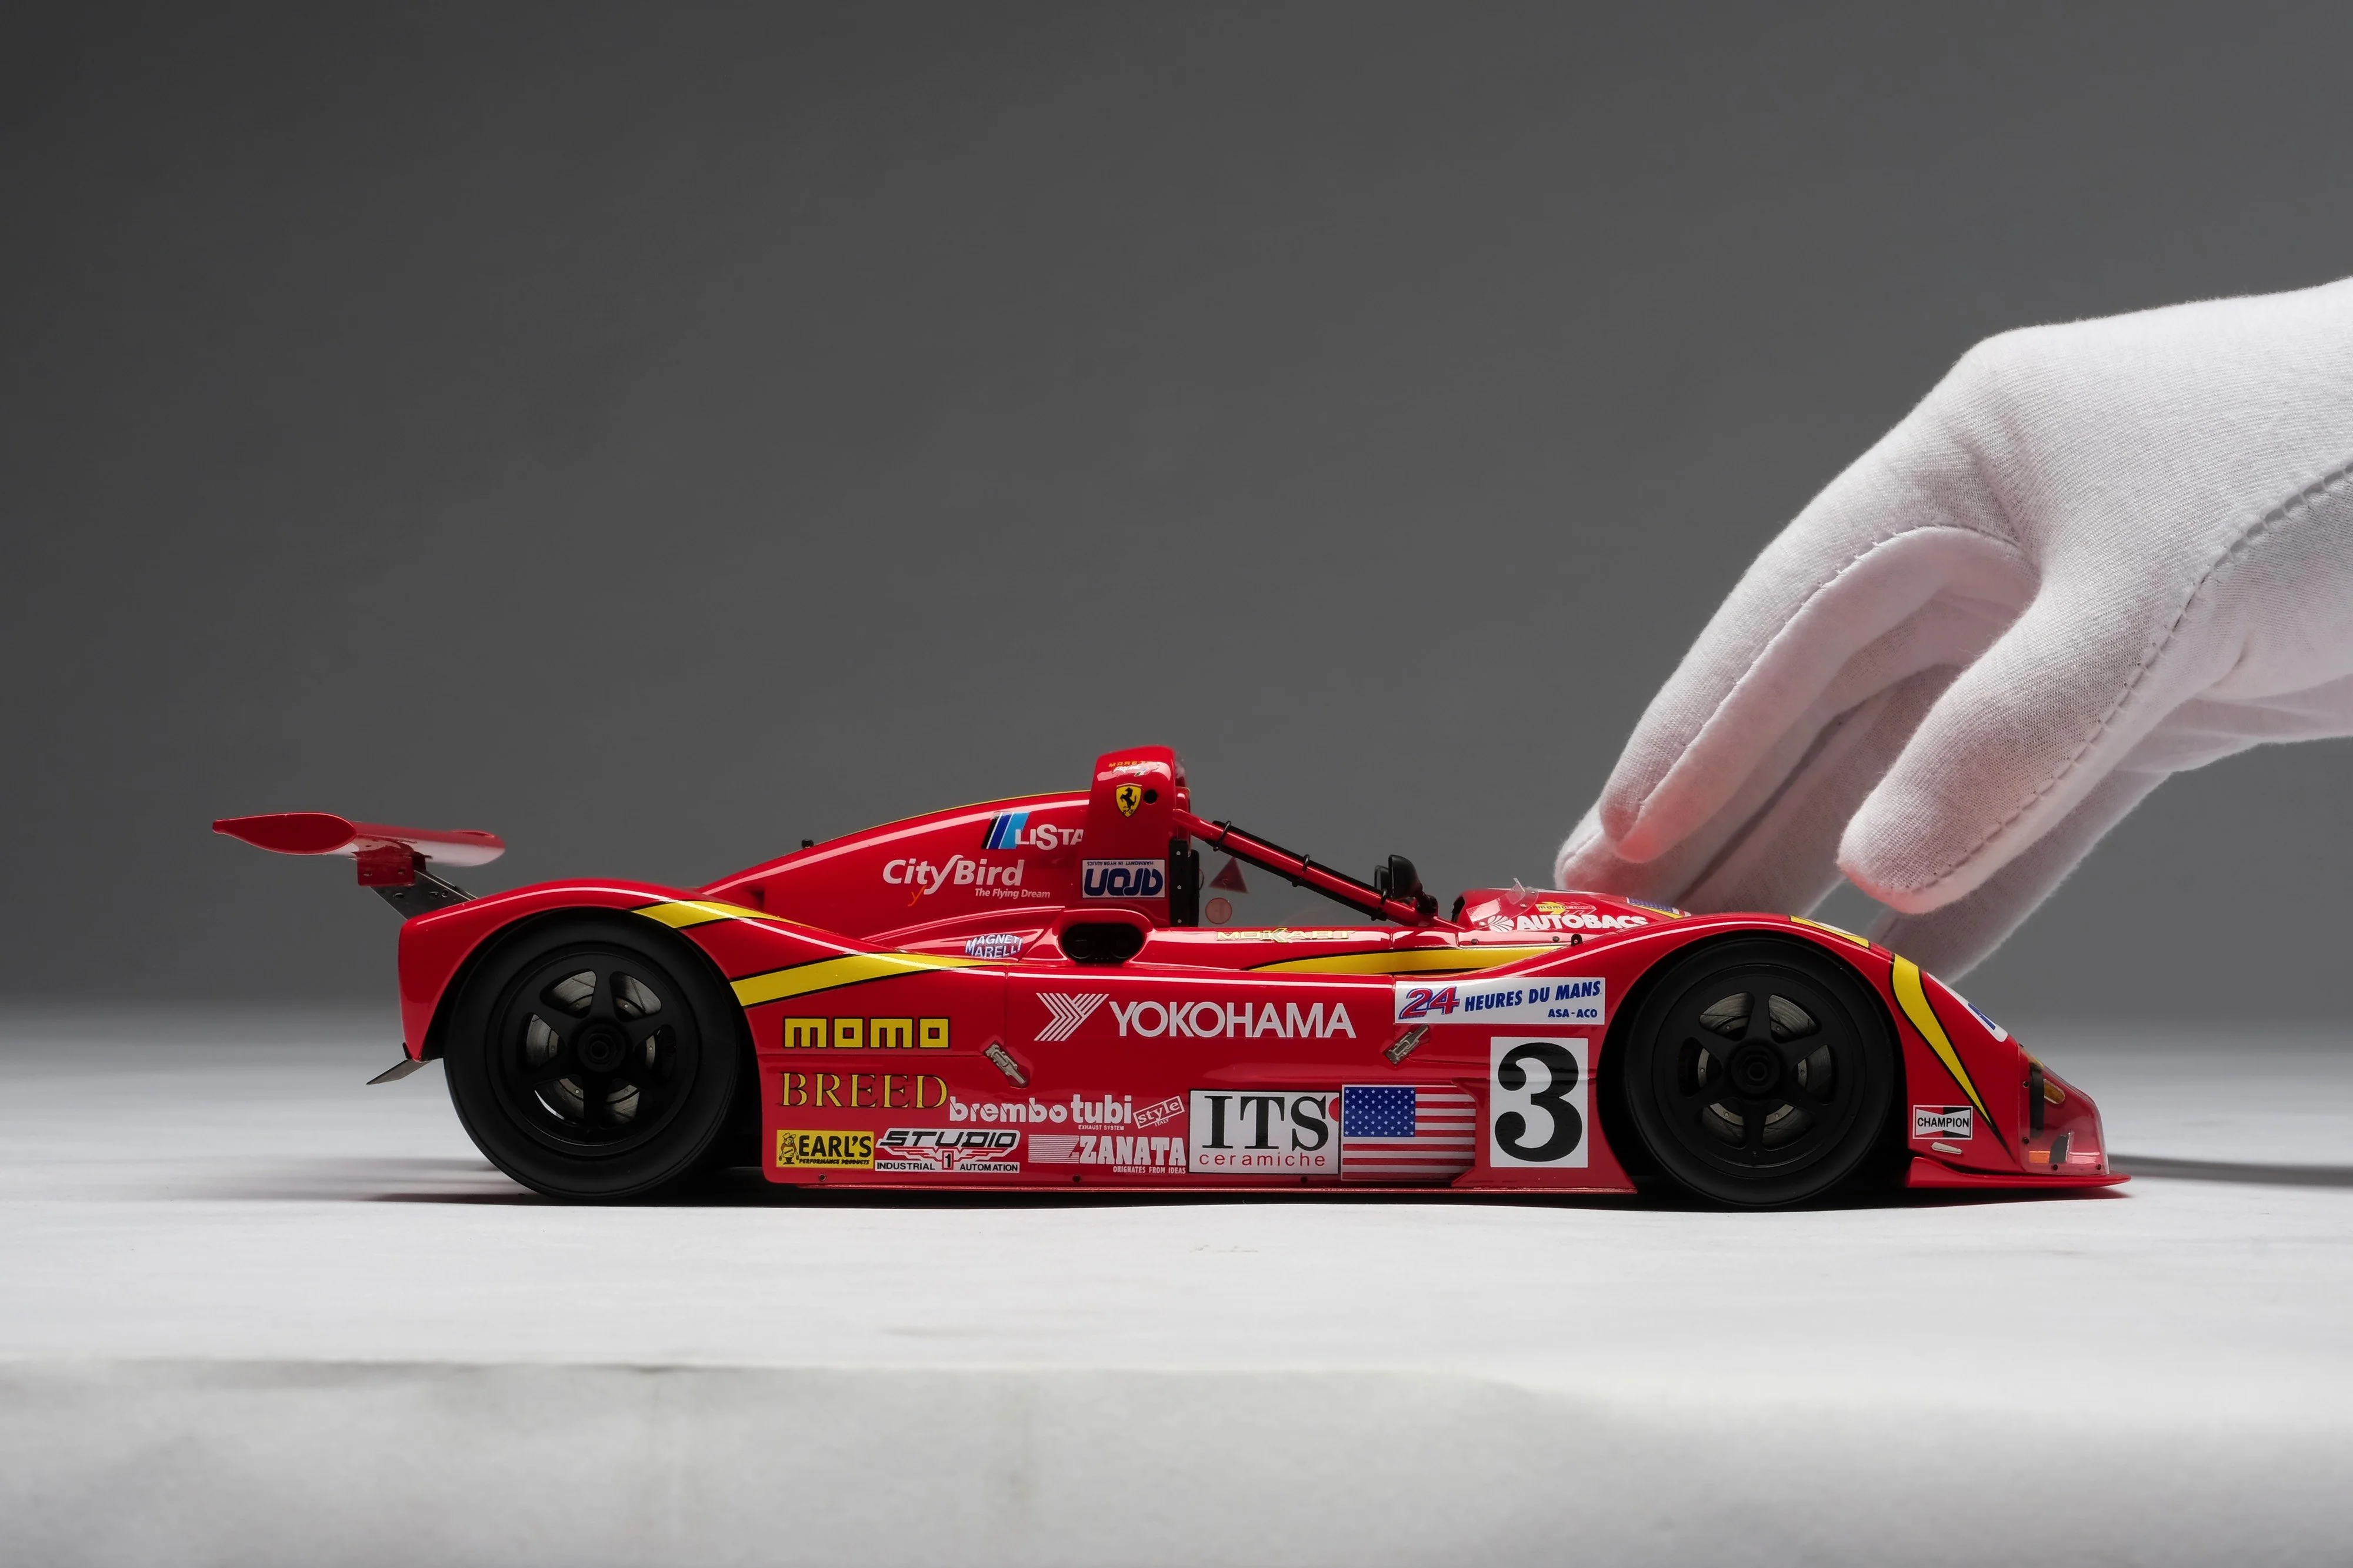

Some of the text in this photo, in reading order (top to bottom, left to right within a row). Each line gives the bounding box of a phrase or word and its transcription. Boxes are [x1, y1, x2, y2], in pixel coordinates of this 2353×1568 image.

[975, 888, 1051, 899] The Flying Dream
[1517, 915, 1649, 930] AUTOBACS
[1398, 980, 1601, 1020] 24 HEURES DU MANS
[1109, 1001, 1357, 1038] YOKOHAMA
[779, 1072, 948, 1109] BREED
[949, 1094, 1179, 1124] brembo tubi style
[1495, 1043, 1582, 1162] 3
[1155, 1118, 1169, 1127] ITALY
[1202, 1095, 1329, 1152] ITS
[1917, 1117, 1969, 1128] CHAMPION
[799, 1135, 872, 1157] EARL'S
[879, 1130, 1017, 1147] STUDIO
[1079, 1135, 1187, 1166] ZANATA
[1199, 1152, 1325, 1166] ceramiche
[876, 1153, 1018, 1172] INDUSTRIAL 1 AUTOMATION
